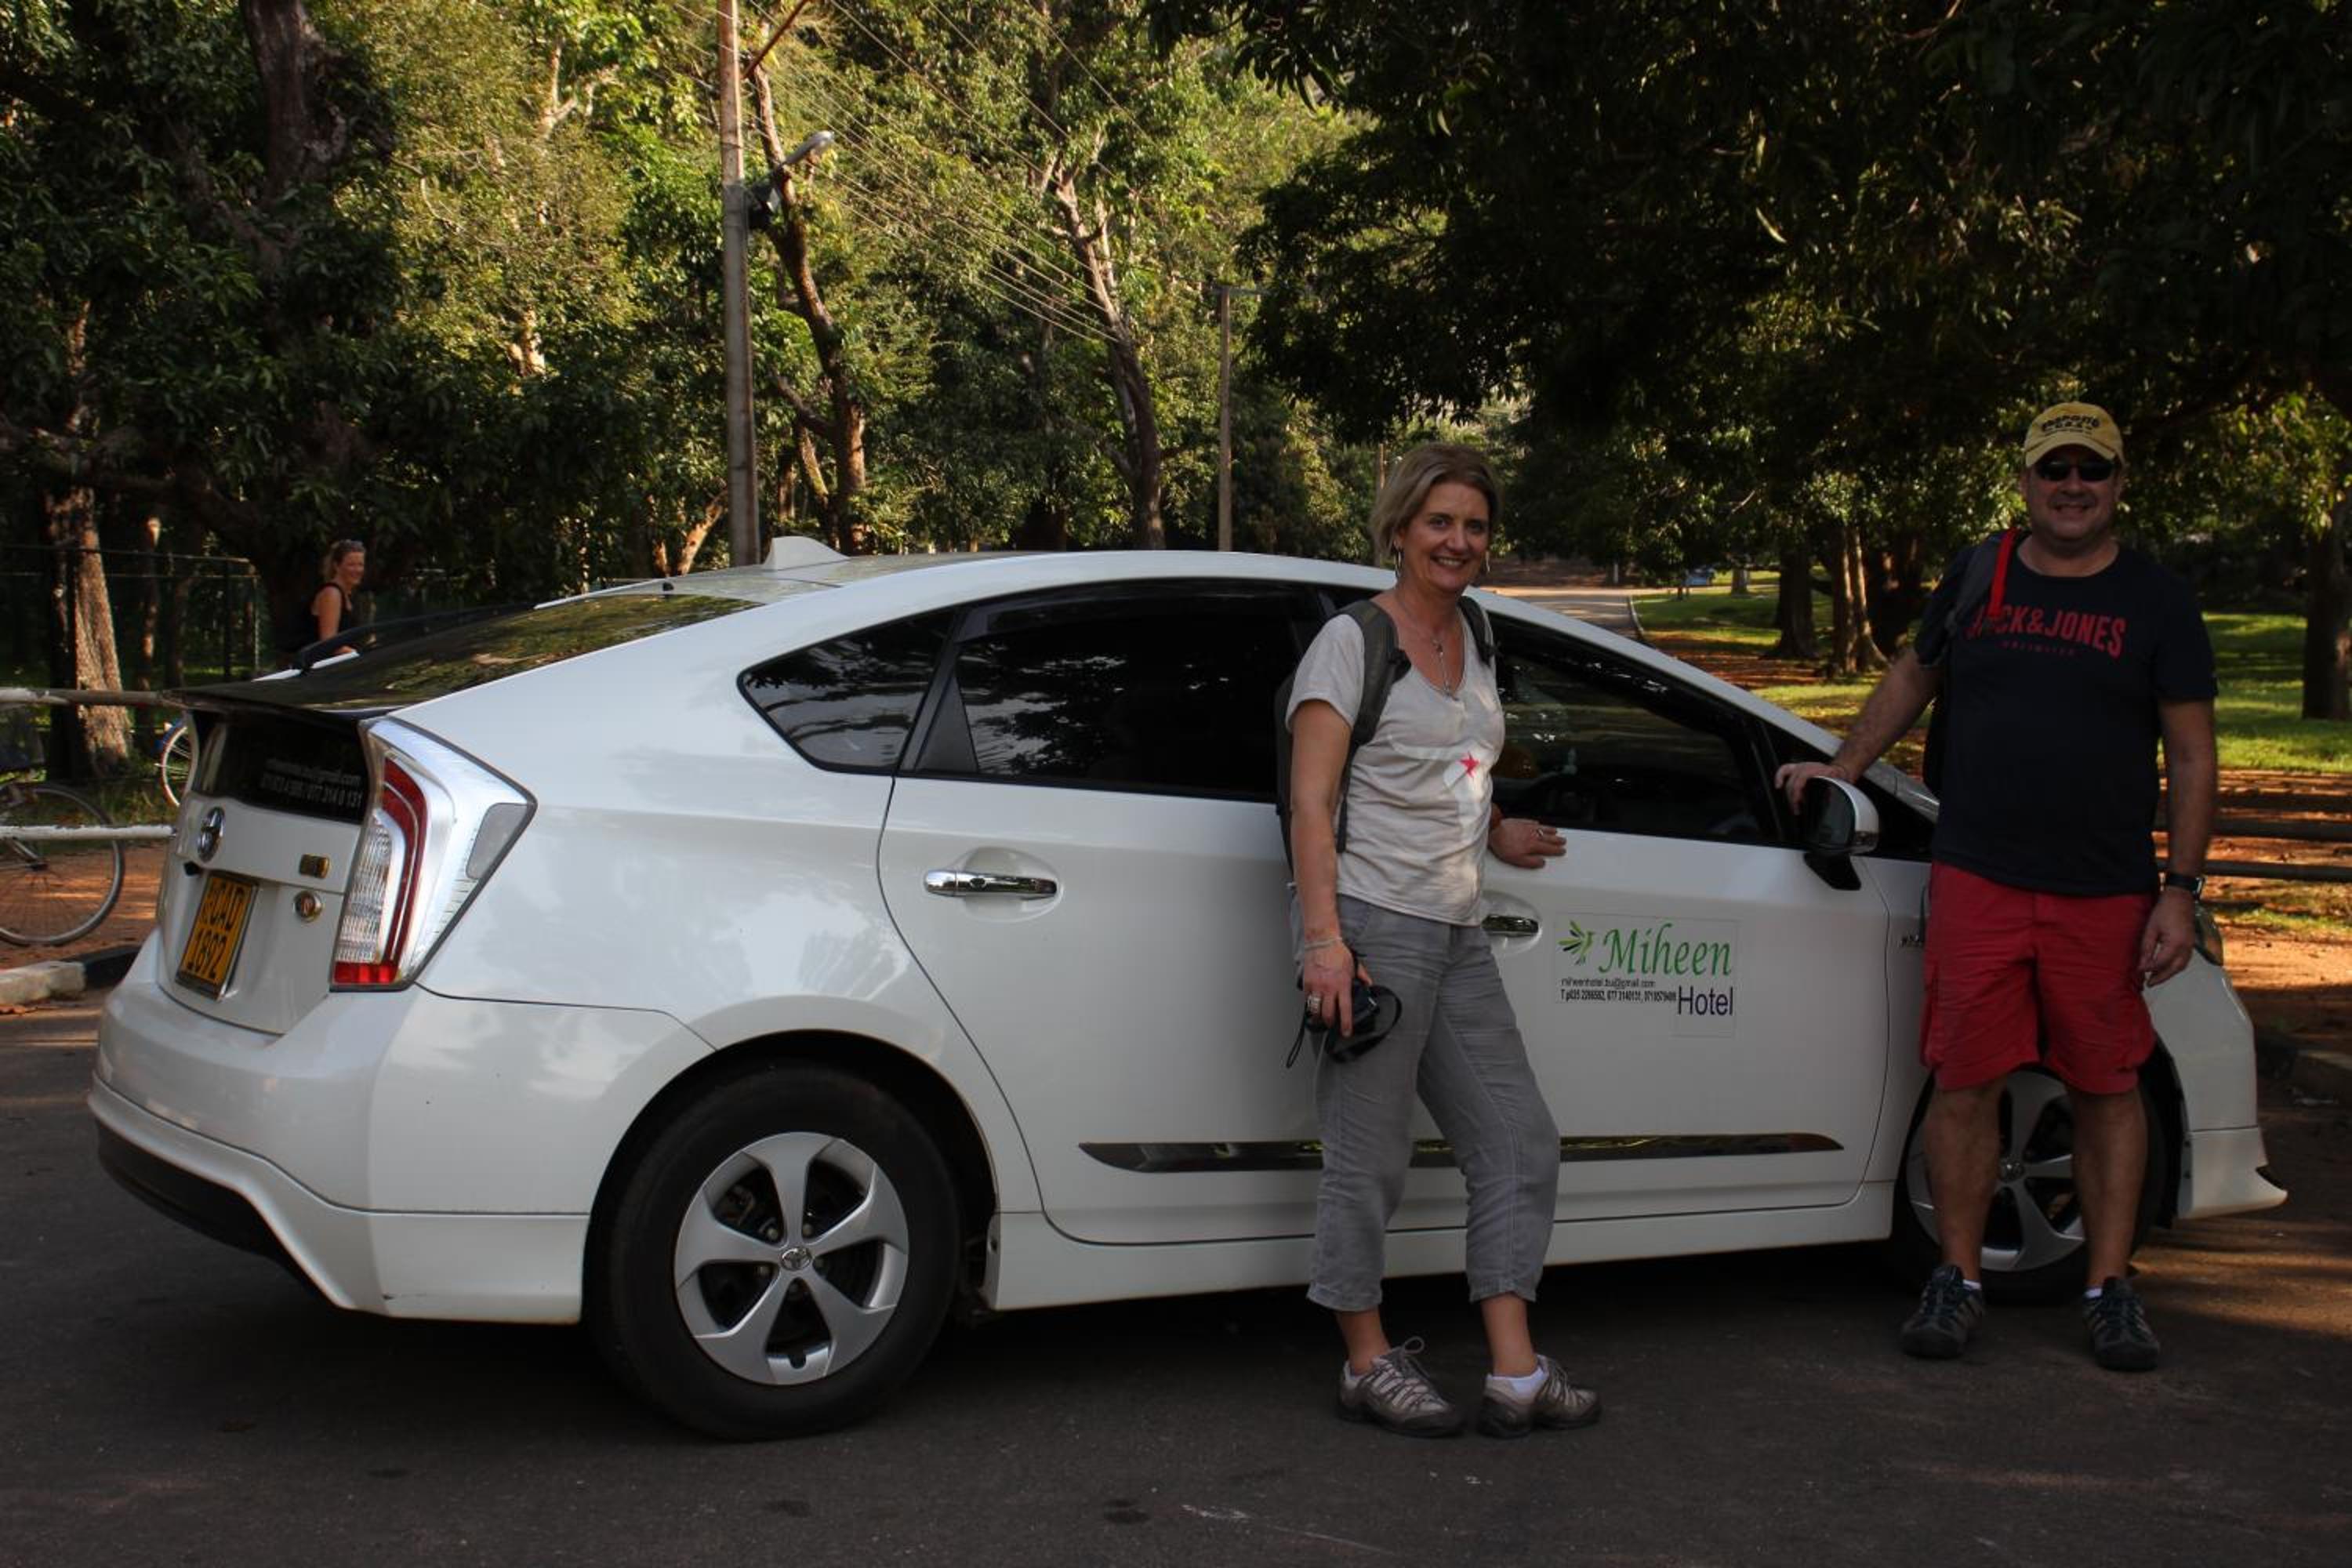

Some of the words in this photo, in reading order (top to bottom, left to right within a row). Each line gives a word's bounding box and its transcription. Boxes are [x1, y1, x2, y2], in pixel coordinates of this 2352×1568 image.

[1963, 602, 2128, 659] JCK&JONES
[1599, 923, 1732, 975] Miheen
[1677, 985, 1733, 1015] Hotel
